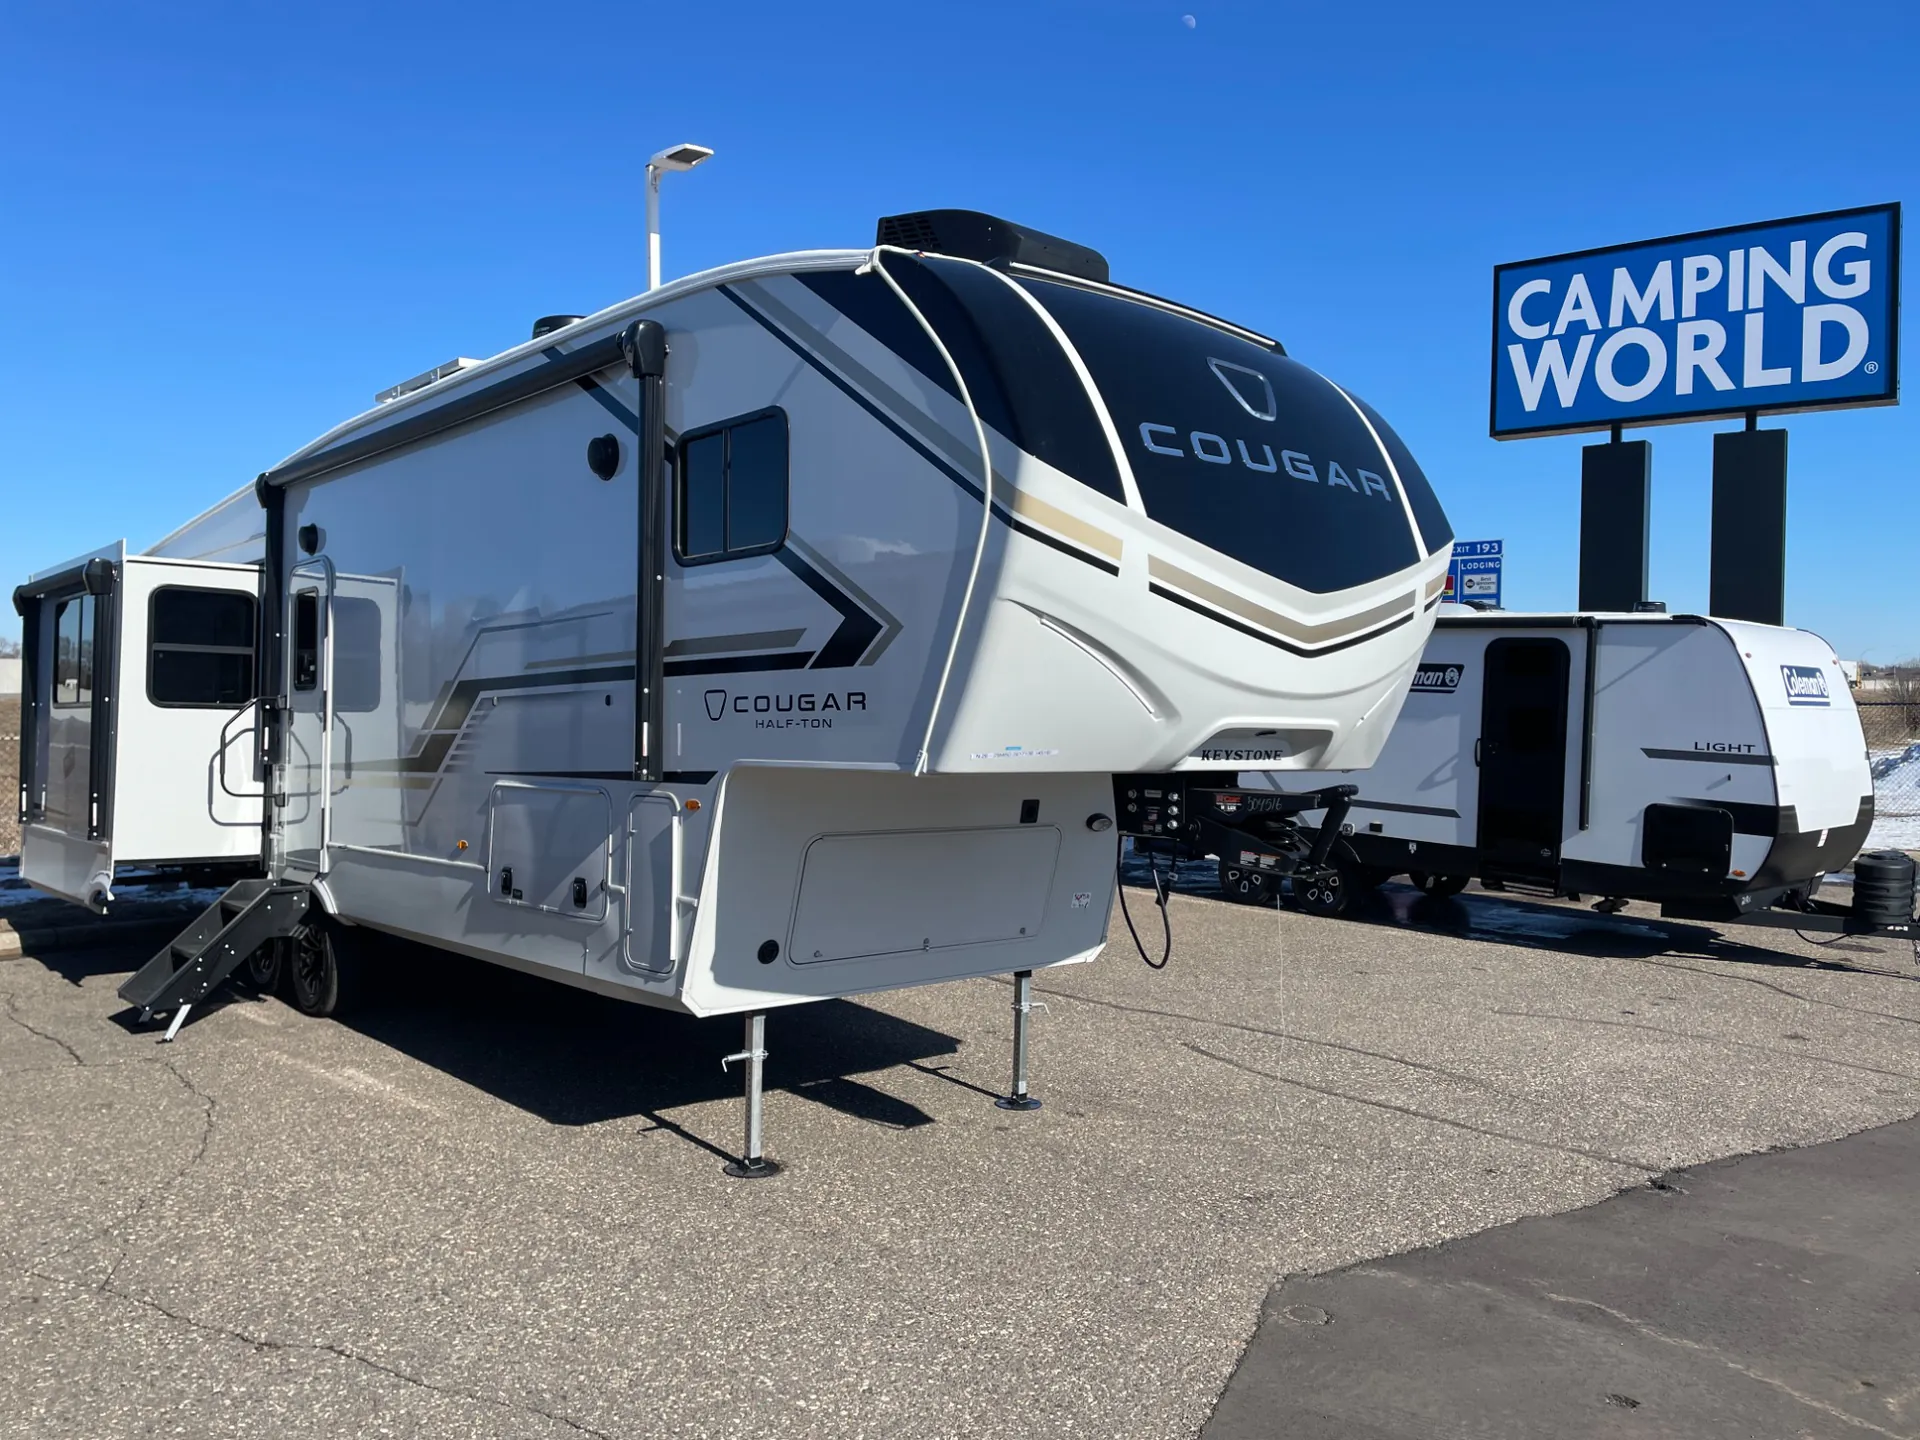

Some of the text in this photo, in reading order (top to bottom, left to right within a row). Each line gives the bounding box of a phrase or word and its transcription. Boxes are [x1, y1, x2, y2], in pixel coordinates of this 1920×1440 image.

[1507, 231, 1871, 340] CAMPING
[1138, 422, 1392, 501] COUGAR
[1477, 543, 1499, 554] 193
[1461, 561, 1501, 570] LODGING
[1783, 667, 1822, 696] Coleman
[733, 692, 867, 713] COUGAR
[755, 718, 833, 729] HALF-TON
[1694, 741, 1756, 754] LIGHT
[1201, 749, 1284, 761] KEYSTONE
